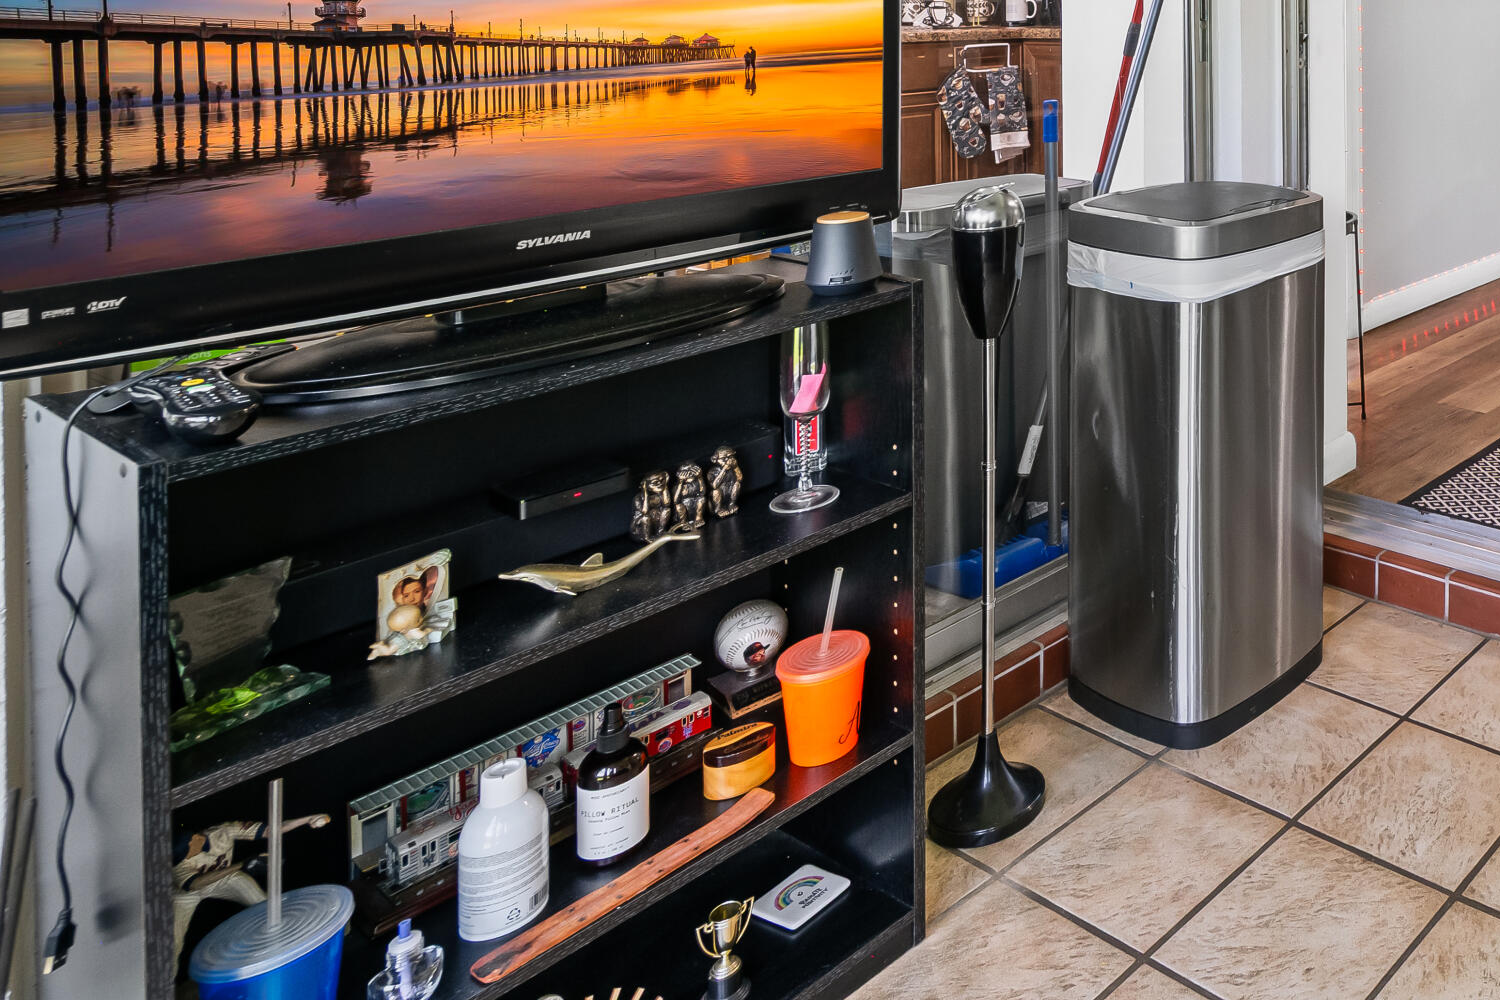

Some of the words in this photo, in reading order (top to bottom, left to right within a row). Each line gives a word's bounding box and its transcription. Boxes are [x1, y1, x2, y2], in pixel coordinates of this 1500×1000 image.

[515, 230, 592, 250] SYLVANIA
[580, 810, 606, 818] PILLOW
[610, 797, 640, 814] RITUAL
